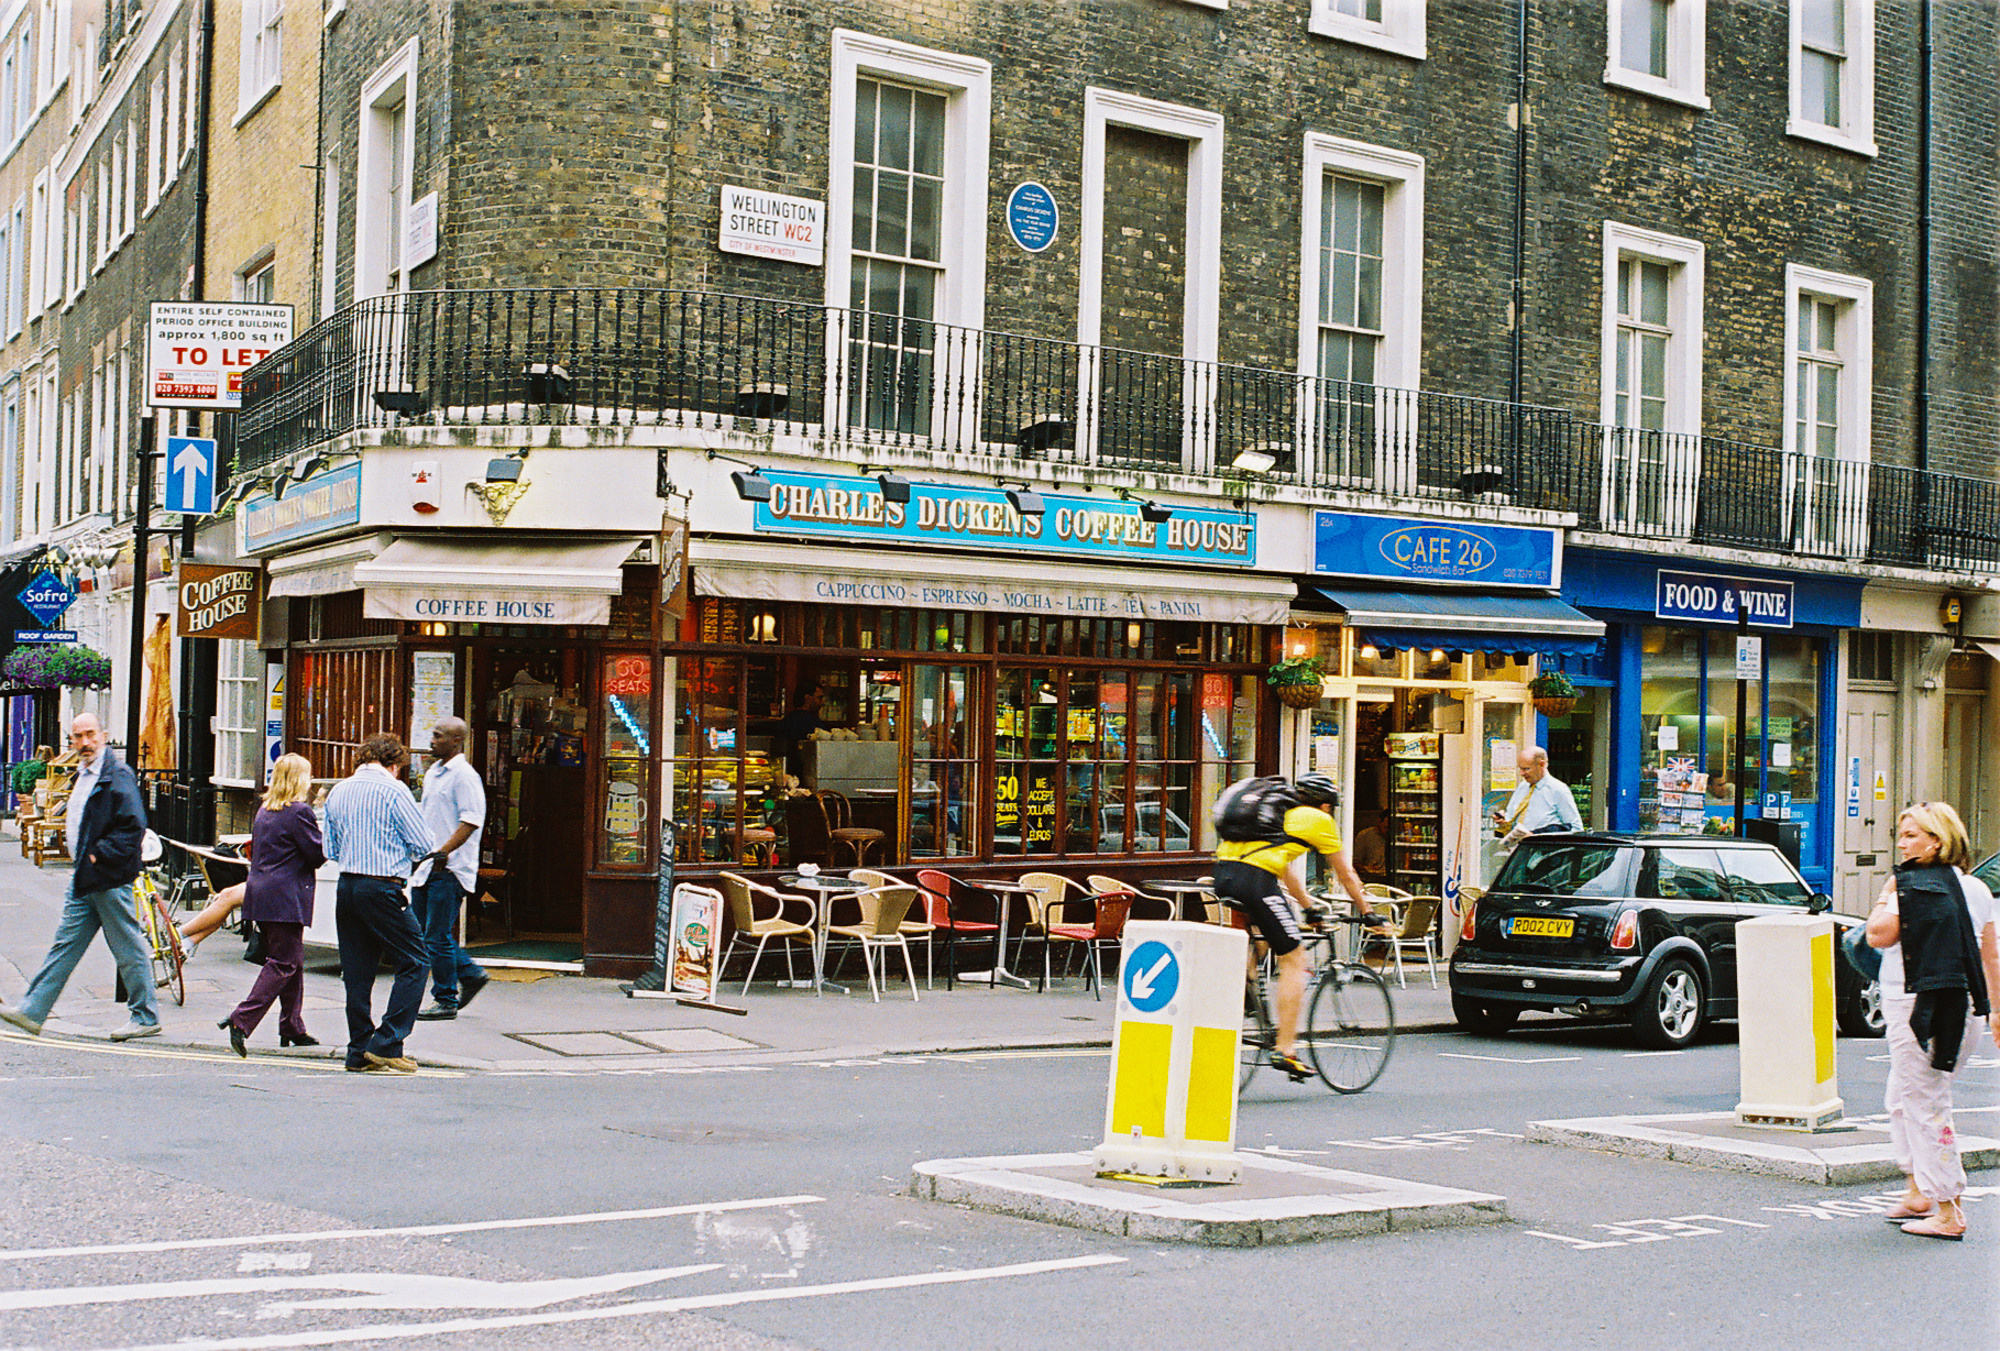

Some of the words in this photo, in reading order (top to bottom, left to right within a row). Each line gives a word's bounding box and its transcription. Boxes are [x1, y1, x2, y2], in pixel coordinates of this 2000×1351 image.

[731, 193, 816, 223] WELLINGTON
[730, 214, 779, 236] STREET
[784, 223, 812, 242] WC2
[729, 240, 743, 248] CITY
[744, 241, 753, 250] OF
[754, 243, 796, 257] WESTMINSTER
[157, 307, 194, 315] ENTIRE
[198, 307, 223, 316] SELF
[227, 308, 287, 318] CONTAINED
[156, 317, 194, 326] PERIOD
[198, 318, 234, 327] OFFICE
[238, 320, 288, 329] BUILDING
[158, 330, 205, 341] approx
[211, 331, 246, 342] 1,800
[251, 333, 267, 343] sq
[273, 332, 284, 341] ft
[172, 347, 208, 366] TO
[222, 348, 271, 366] LET
[156, 384, 172, 393] 020
[174, 384, 194, 394] 7393
[768, 483, 905, 527] CHARLES
[916, 495, 1043, 537] DICKENS
[1055, 507, 1156, 545] COFFEE
[1166, 518, 1248, 552] HOUSE
[1394, 535, 1451, 564] CAFE
[1458, 539, 1482, 567] 26
[1411, 562, 1451, 575] Sandwich
[1452, 565, 1466, 576] Bar
[26, 588, 68, 602] Sofra
[182, 571, 254, 611] COFFEE
[816, 581, 906, 601] CAPPUCCINO
[923, 588, 988, 606] ESPRESSO
[1004, 592, 1052, 609] MOCHA
[1067, 596, 1108, 612] LATTE
[1160, 600, 1202, 616] PANINI
[1664, 583, 1718, 611] FOOD
[1722, 590, 1735, 613] &
[1739, 590, 1786, 617] WINE
[188, 594, 248, 633] HOUSE
[415, 599, 488, 616] COFFEE
[495, 601, 555, 618] HOUSE
[18, 632, 40, 640] ROOF
[42, 632, 75, 641] GARDEN
[609, 679, 650, 693] SEATS
[996, 776, 1019, 801] 50
[1035, 778, 1047, 789] WE
[1029, 790, 1055, 801] ACCEPT
[1766, 793, 1777, 807] P
[996, 802, 1018, 813] SEATS
[1029, 829, 1052, 841] EUROS
[1547, 921, 1571, 934] CVY
[1524, 1214, 1771, 1251] LEFT
